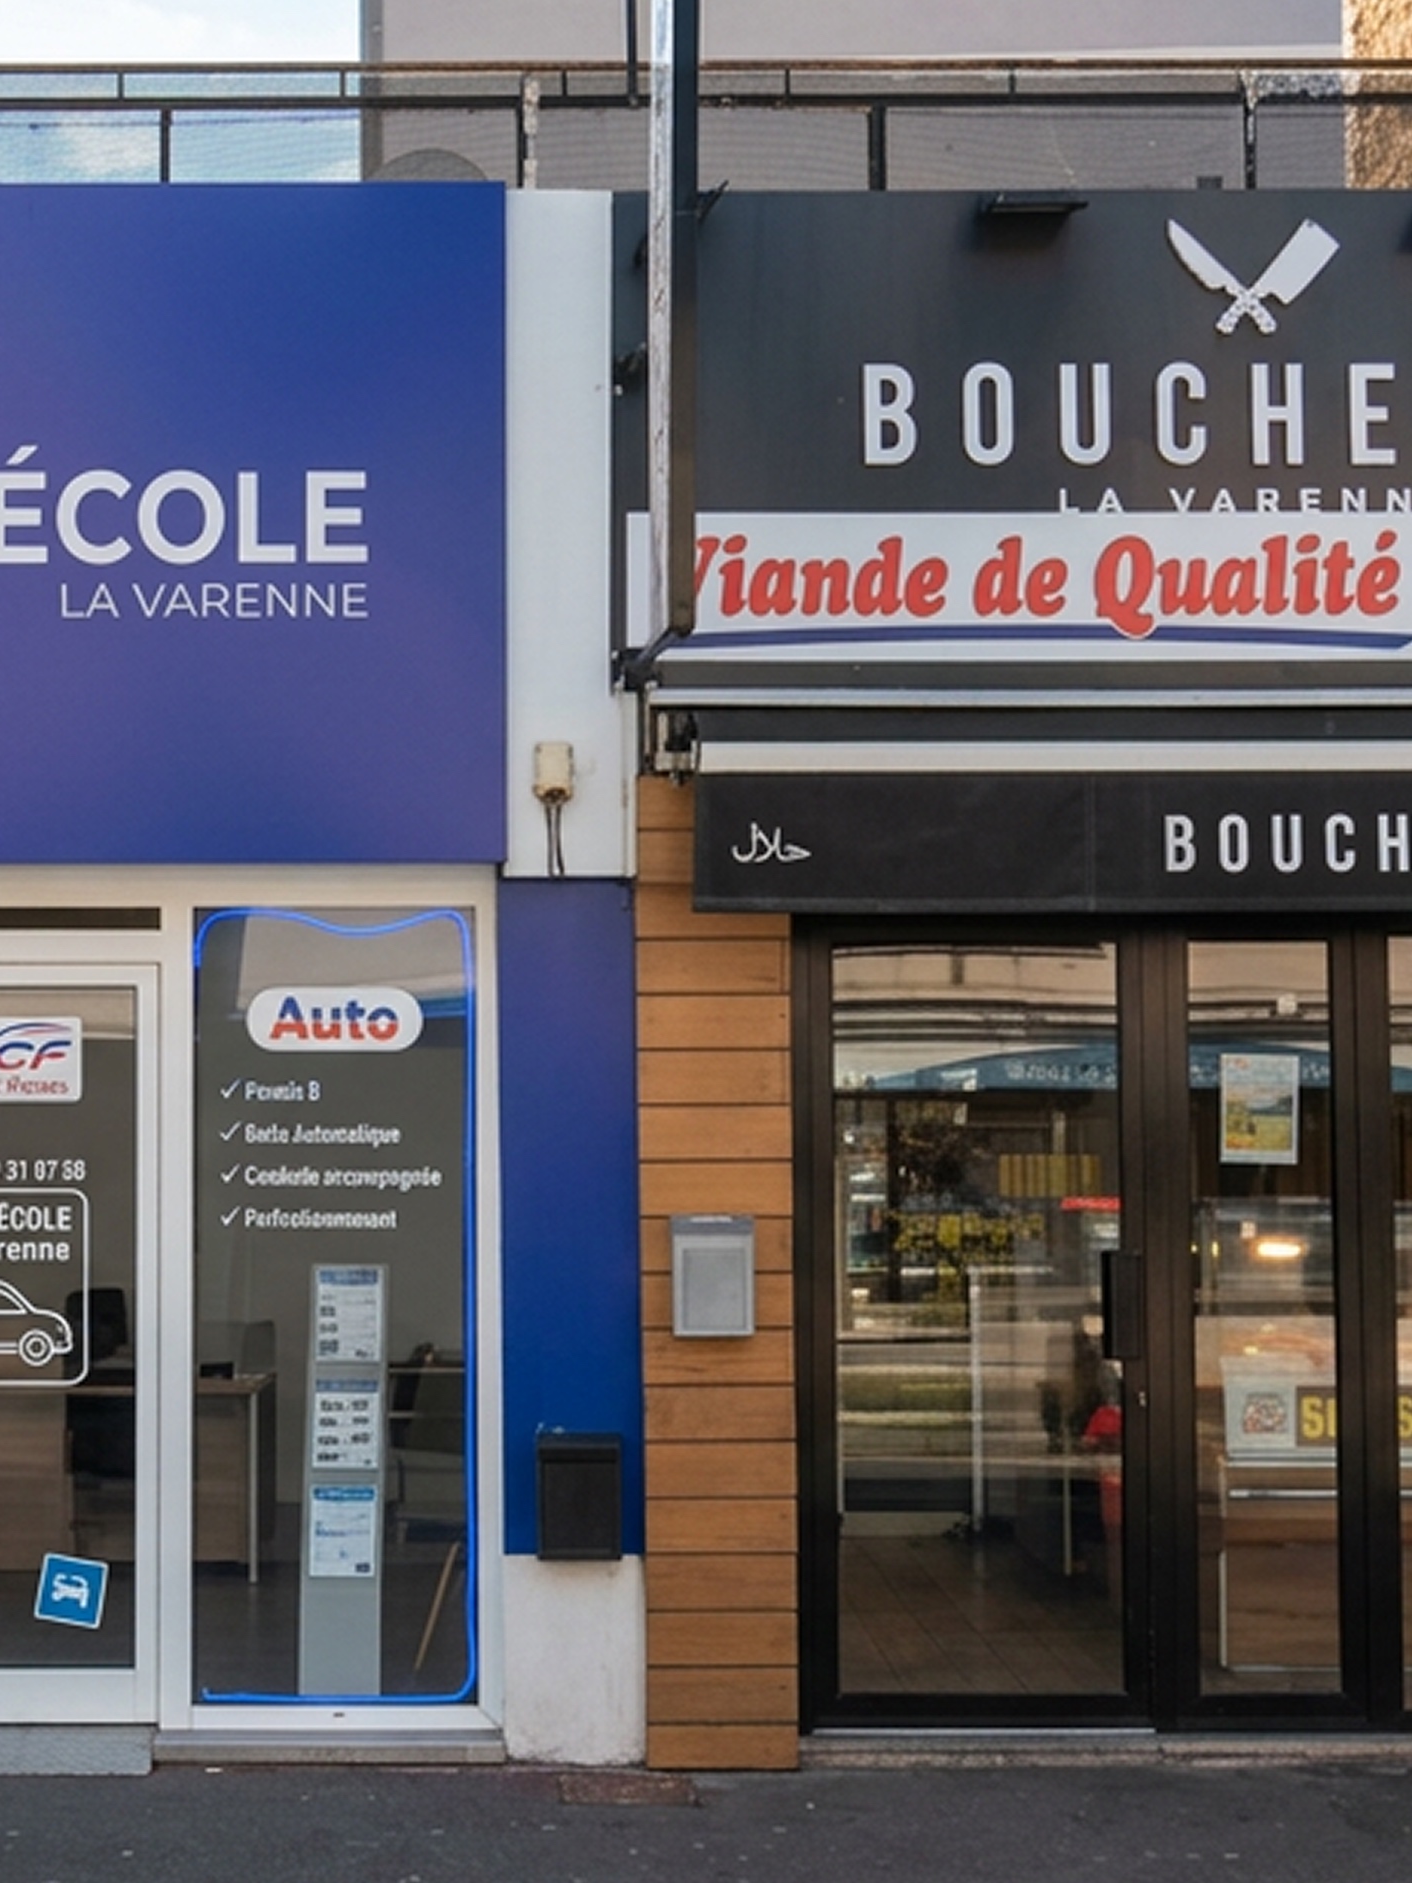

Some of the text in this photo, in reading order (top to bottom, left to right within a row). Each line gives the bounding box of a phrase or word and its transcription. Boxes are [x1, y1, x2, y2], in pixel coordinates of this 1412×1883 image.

[862, 361, 1396, 465] BOUCHE
[1059, 487, 1125, 512] LA
[60, 582, 369, 618] LA VARENNE
[974, 535, 1068, 618] de
[1093, 529, 1401, 638] Qualité
[731, 822, 812, 863] حلال
[1164, 813, 1411, 873] BOUCH
[269, 996, 399, 1041] Auto
